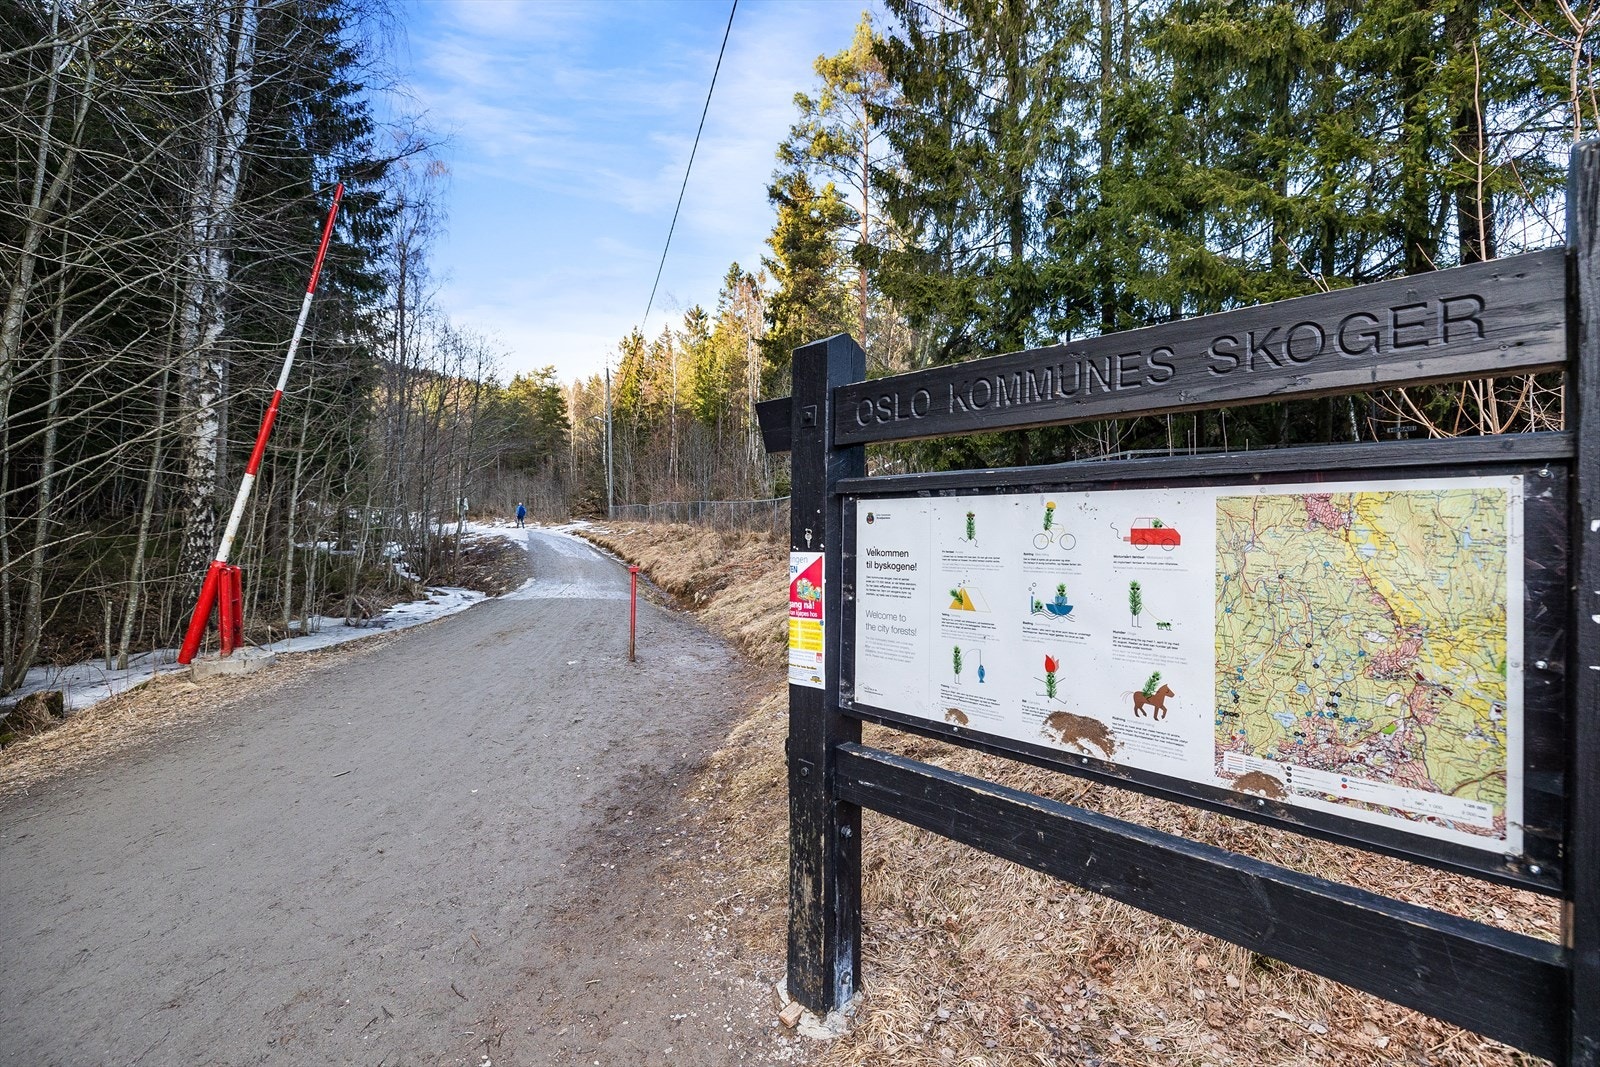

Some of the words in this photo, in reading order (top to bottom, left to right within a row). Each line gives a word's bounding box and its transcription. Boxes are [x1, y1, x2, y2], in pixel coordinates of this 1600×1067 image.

[856, 388, 932, 427] OSLO
[949, 345, 1176, 414] KOMMUNES
[1206, 293, 1486, 378] SKOGER
[866, 548, 909, 558] Velkommen
[874, 561, 918, 572] byskogene!
[865, 610, 898, 621] Welcome
[899, 614, 907, 622] to
[865, 623, 876, 631] the
[877, 624, 890, 634] city
[891, 625, 917, 636] forests!
